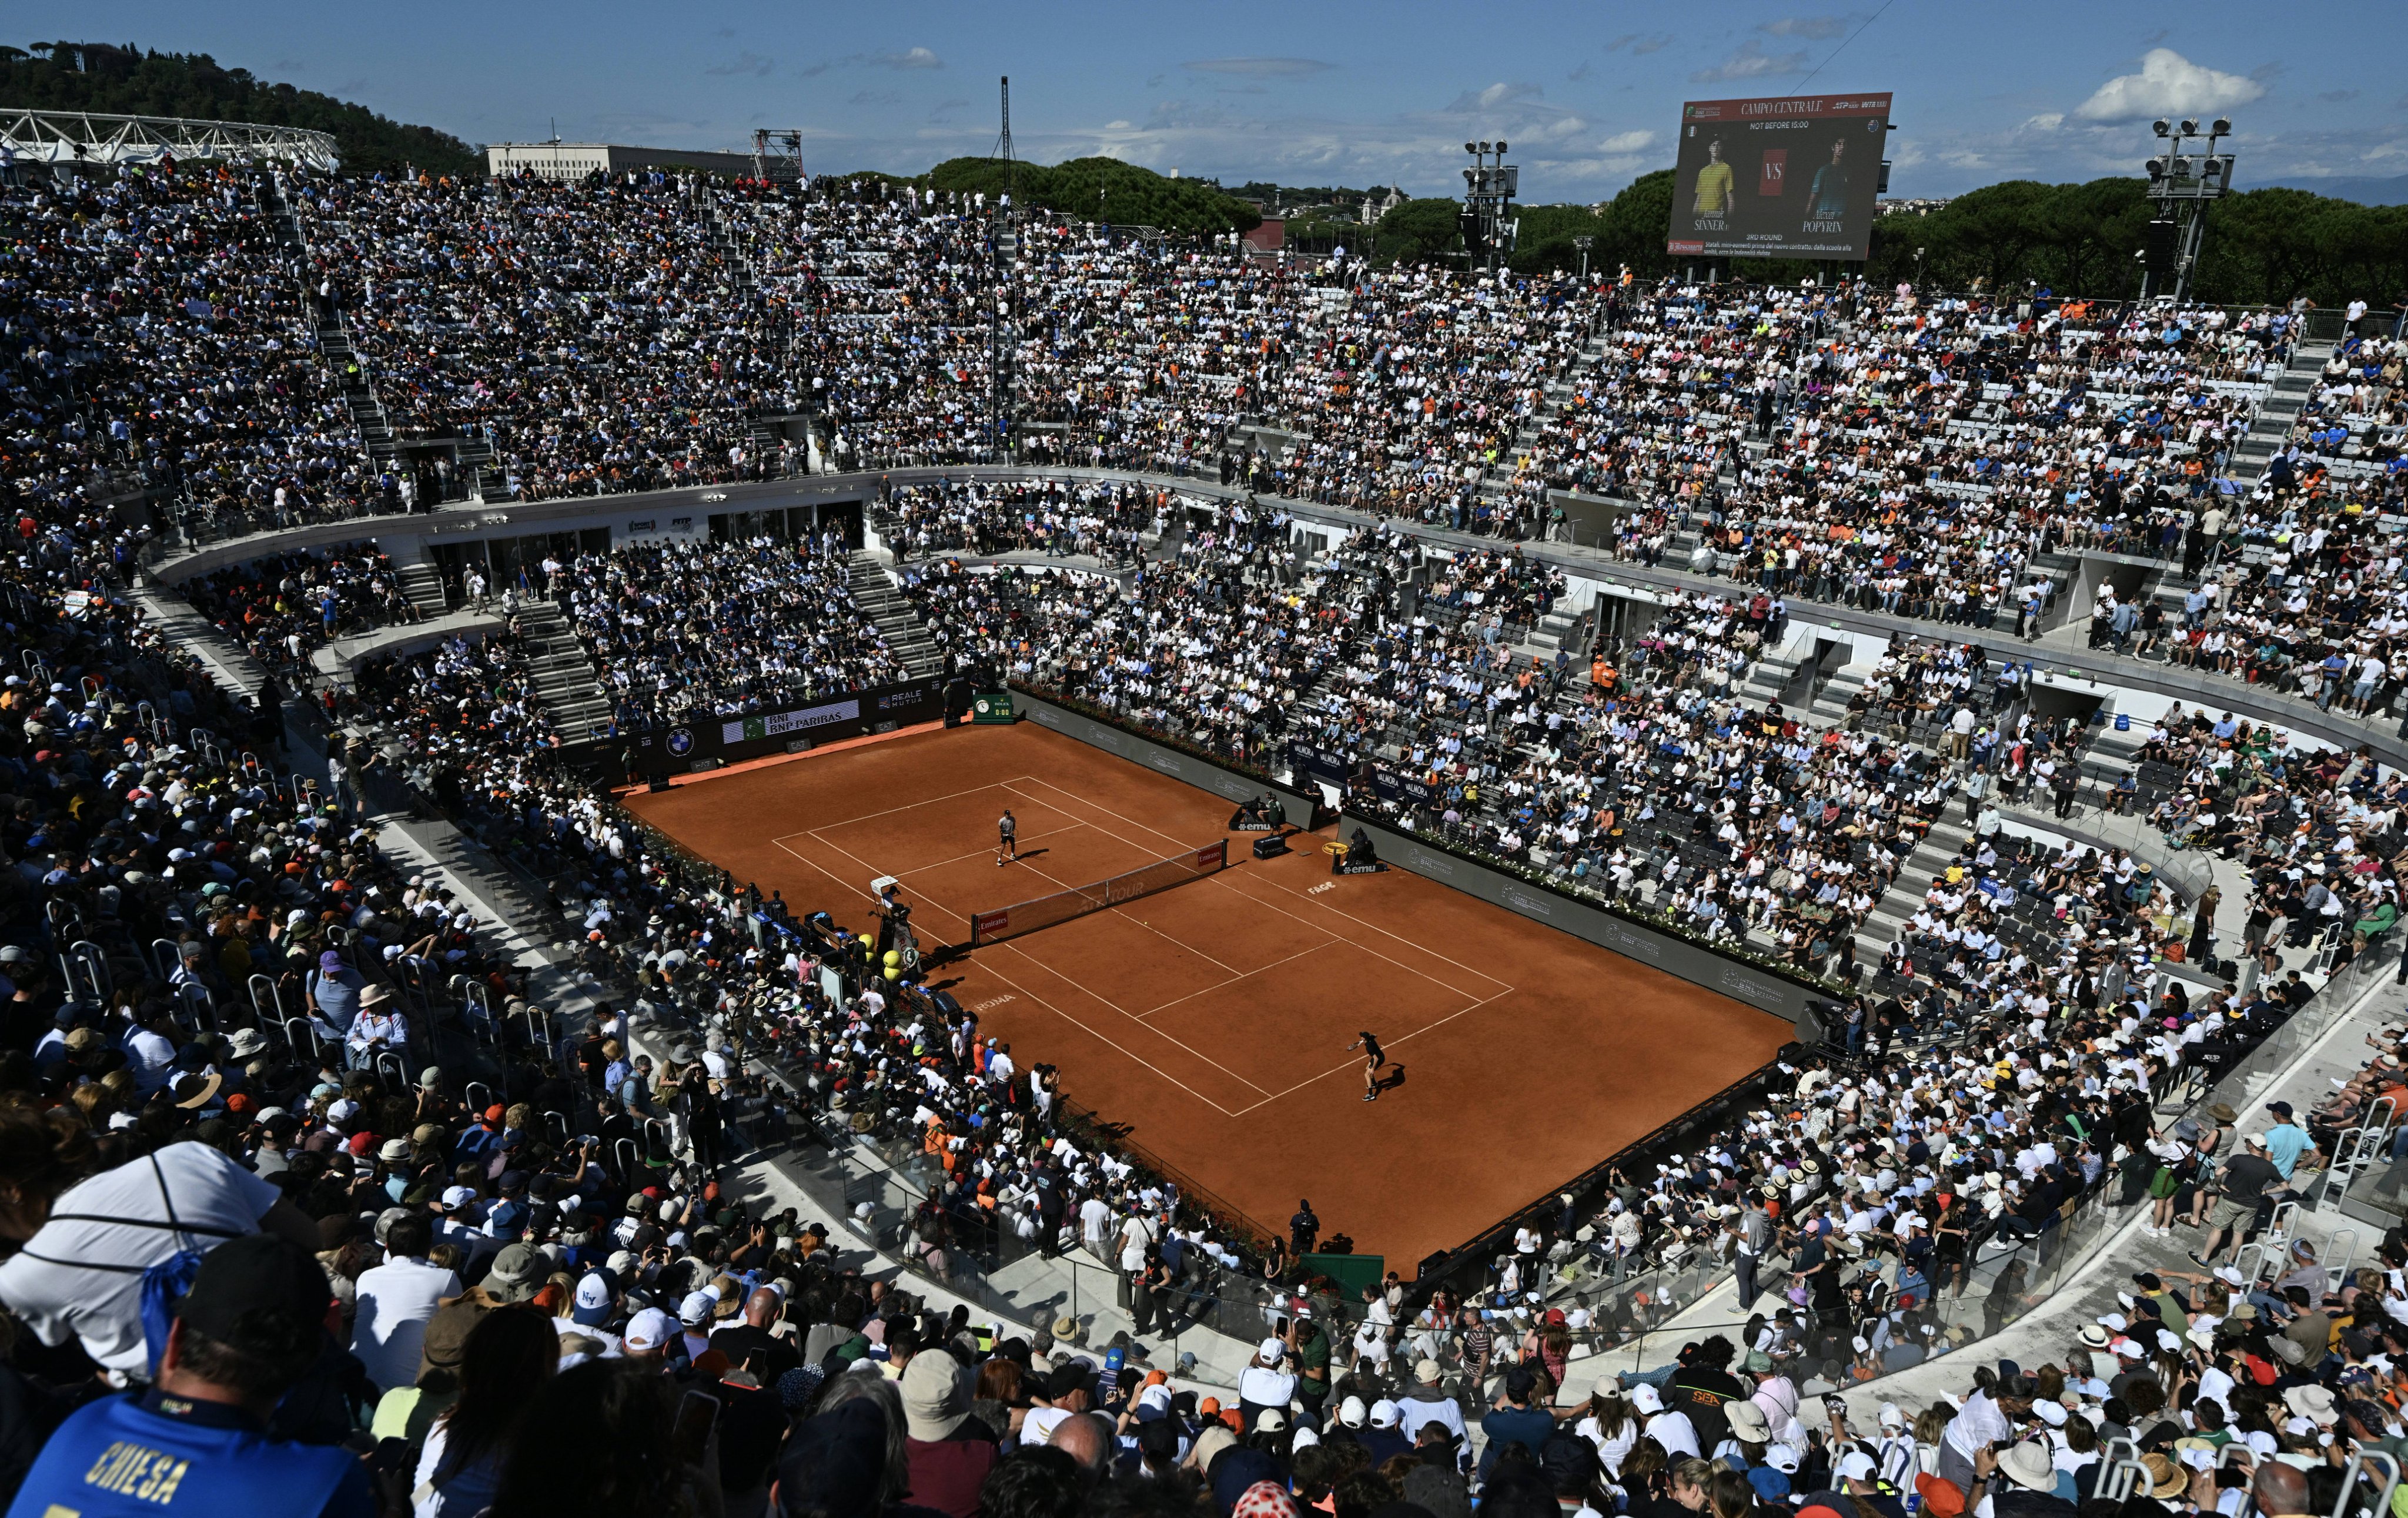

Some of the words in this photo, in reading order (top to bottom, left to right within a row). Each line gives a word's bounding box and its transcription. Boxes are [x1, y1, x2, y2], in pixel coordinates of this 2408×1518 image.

[1741, 102, 1772, 115] CAMPO
[1774, 101, 1823, 113] CENTRALE
[1766, 163, 1781, 180] VS
[1694, 219, 1724, 230] SINNER
[1802, 221, 1843, 233] POPYRIN
[892, 690, 922, 702] REALE
[892, 698, 922, 707] MUTUA
[770, 723, 794, 734] BNP
[796, 712, 842, 728] PARIBAS
[1295, 745, 1314, 757] VALMORA
[1320, 754, 1340, 767] VALMORA
[1377, 774, 1399, 787] VALMORA
[1405, 784, 1428, 797] VALMORA
[1199, 851, 1220, 862] Emirates
[1110, 882, 1144, 902] TOUR
[981, 918, 1006, 929] Emirates
[974, 994, 1016, 1011] ROMA
[2362, 1139, 2375, 1151] 01
[583, 1290, 596, 1305] NY
[1694, 1390, 1720, 1405] SEA
[85, 1442, 190, 1505] CHIESA
